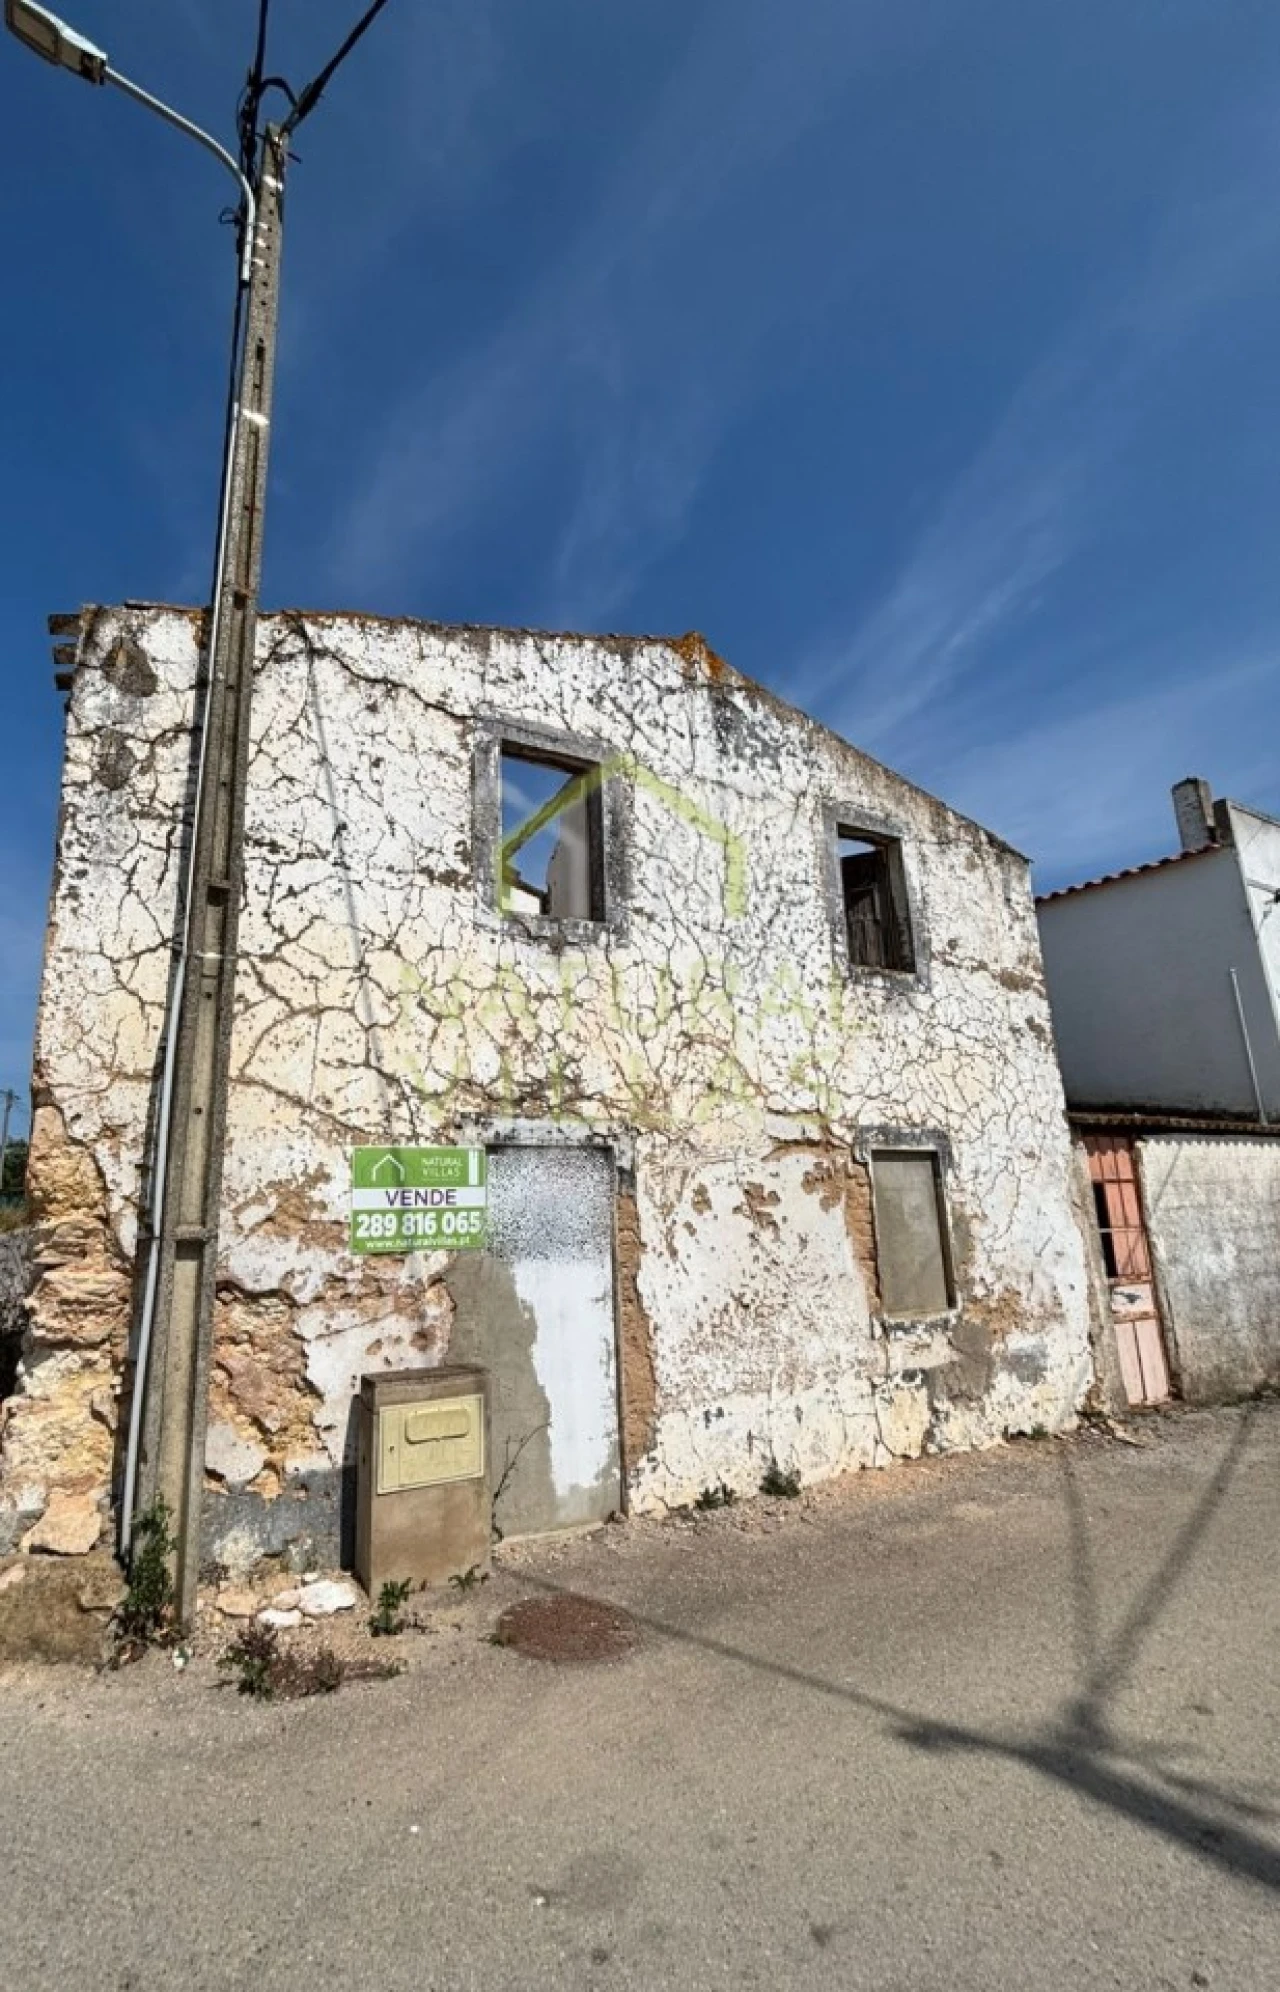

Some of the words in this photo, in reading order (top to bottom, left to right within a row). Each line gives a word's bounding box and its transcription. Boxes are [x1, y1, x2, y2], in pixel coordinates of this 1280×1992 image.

[422, 1157, 462, 1166] NATURAL
[423, 1168, 460, 1177] VILLAS
[386, 1189, 457, 1206] VENDE
[356, 1213, 397, 1237] 289
[402, 1211, 437, 1235] 816
[442, 1211, 481, 1234] 065
